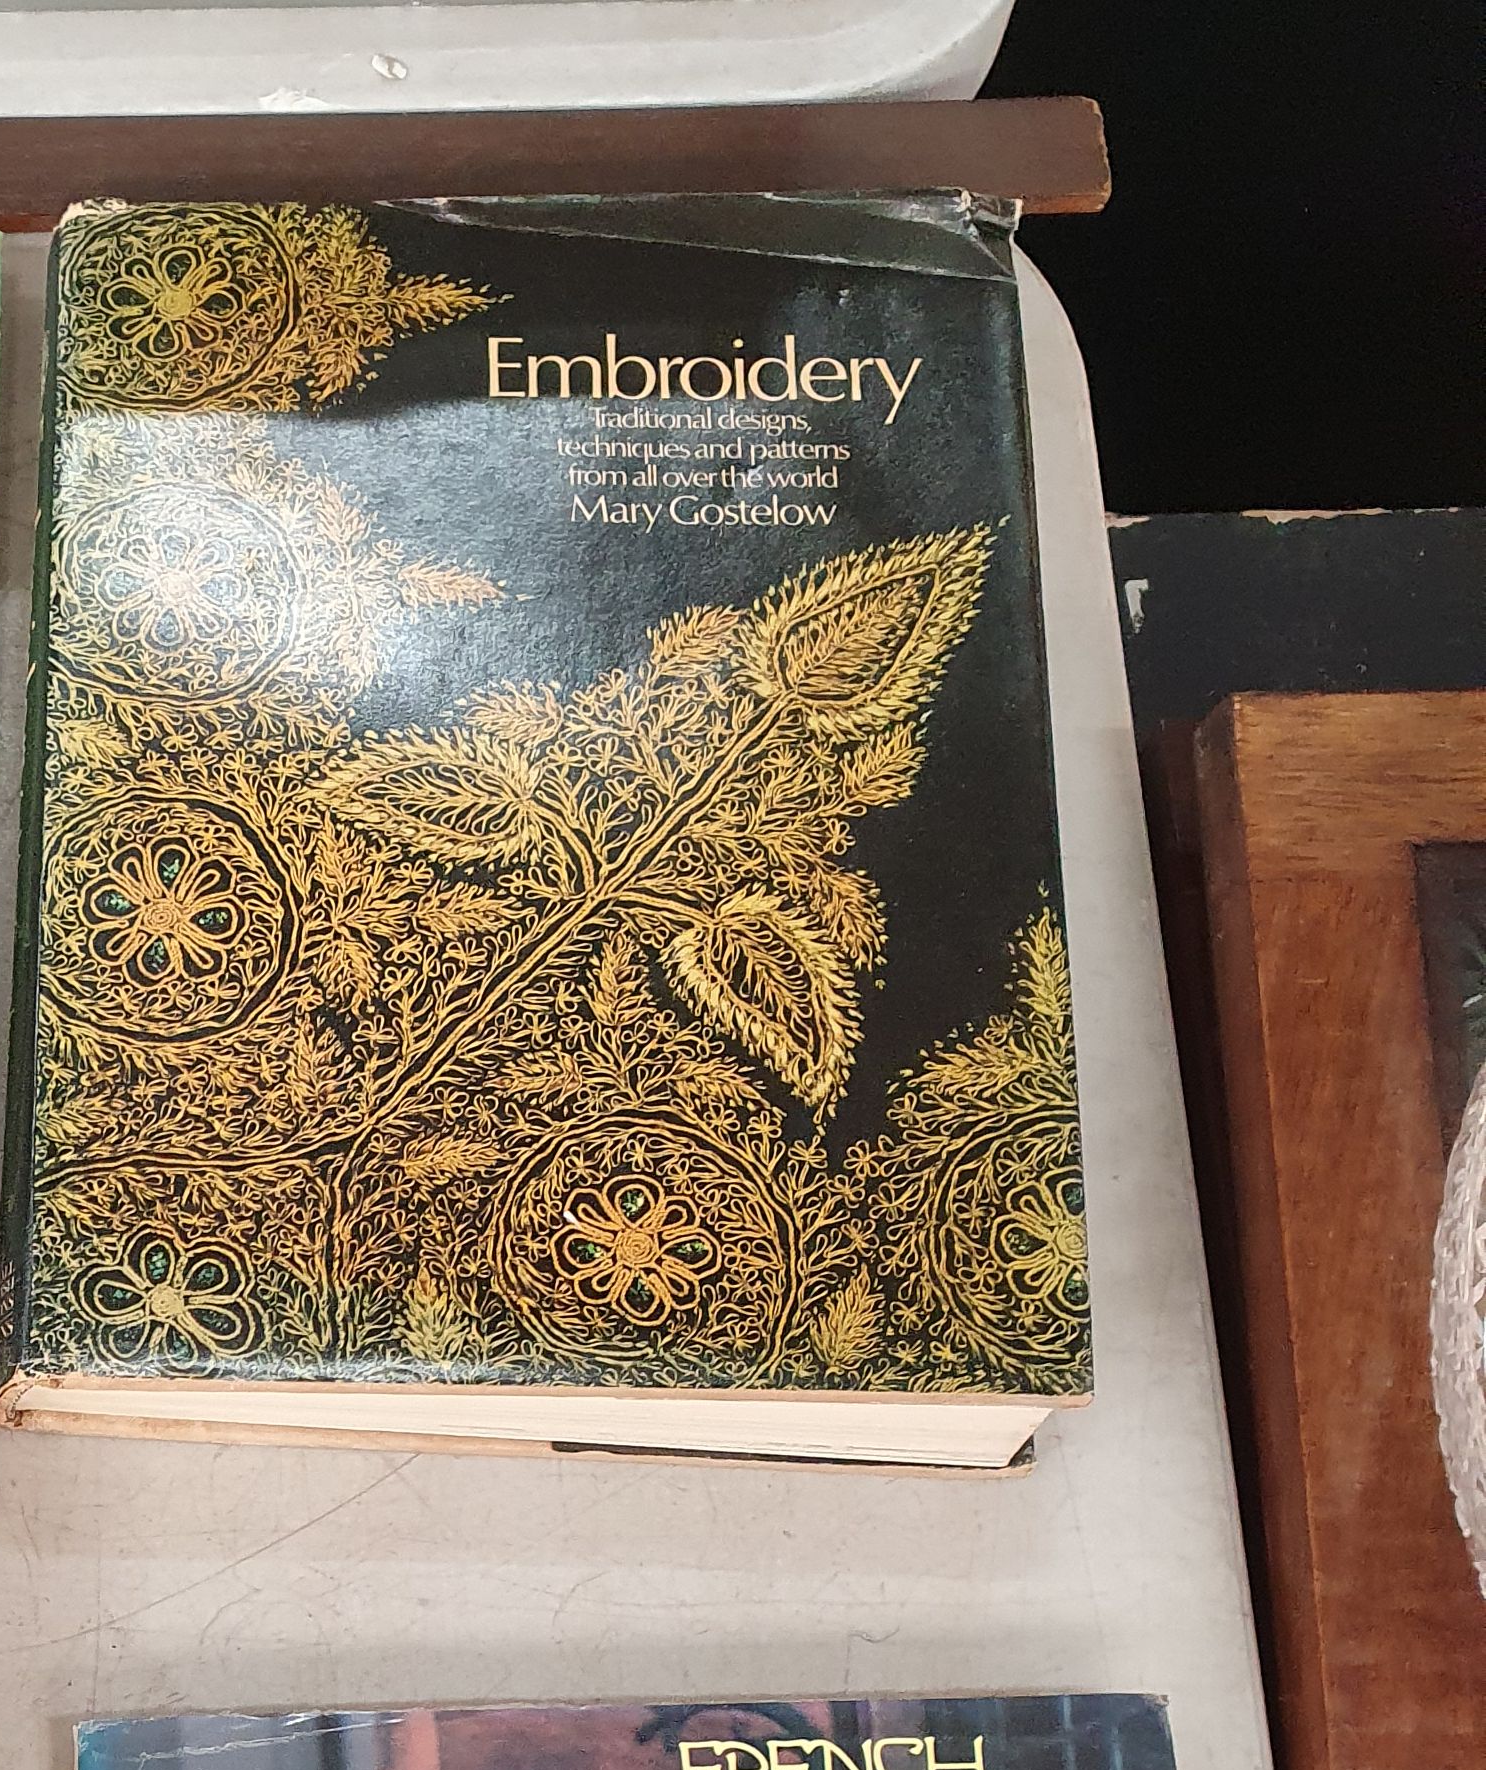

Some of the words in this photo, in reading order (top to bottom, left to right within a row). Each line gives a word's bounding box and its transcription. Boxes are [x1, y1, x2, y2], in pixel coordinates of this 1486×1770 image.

[488, 333, 922, 424] Embroidery
[592, 407, 712, 430] Traditional
[557, 436, 691, 463] techniques
[694, 436, 742, 460] and
[750, 439, 850, 465] patterns
[569, 464, 627, 487] from
[632, 463, 658, 487] all
[662, 470, 718, 488] over
[720, 464, 763, 488] the
[767, 464, 838, 489] world
[570, 495, 662, 533] Mary
[670, 495, 837, 526] Gostelow
